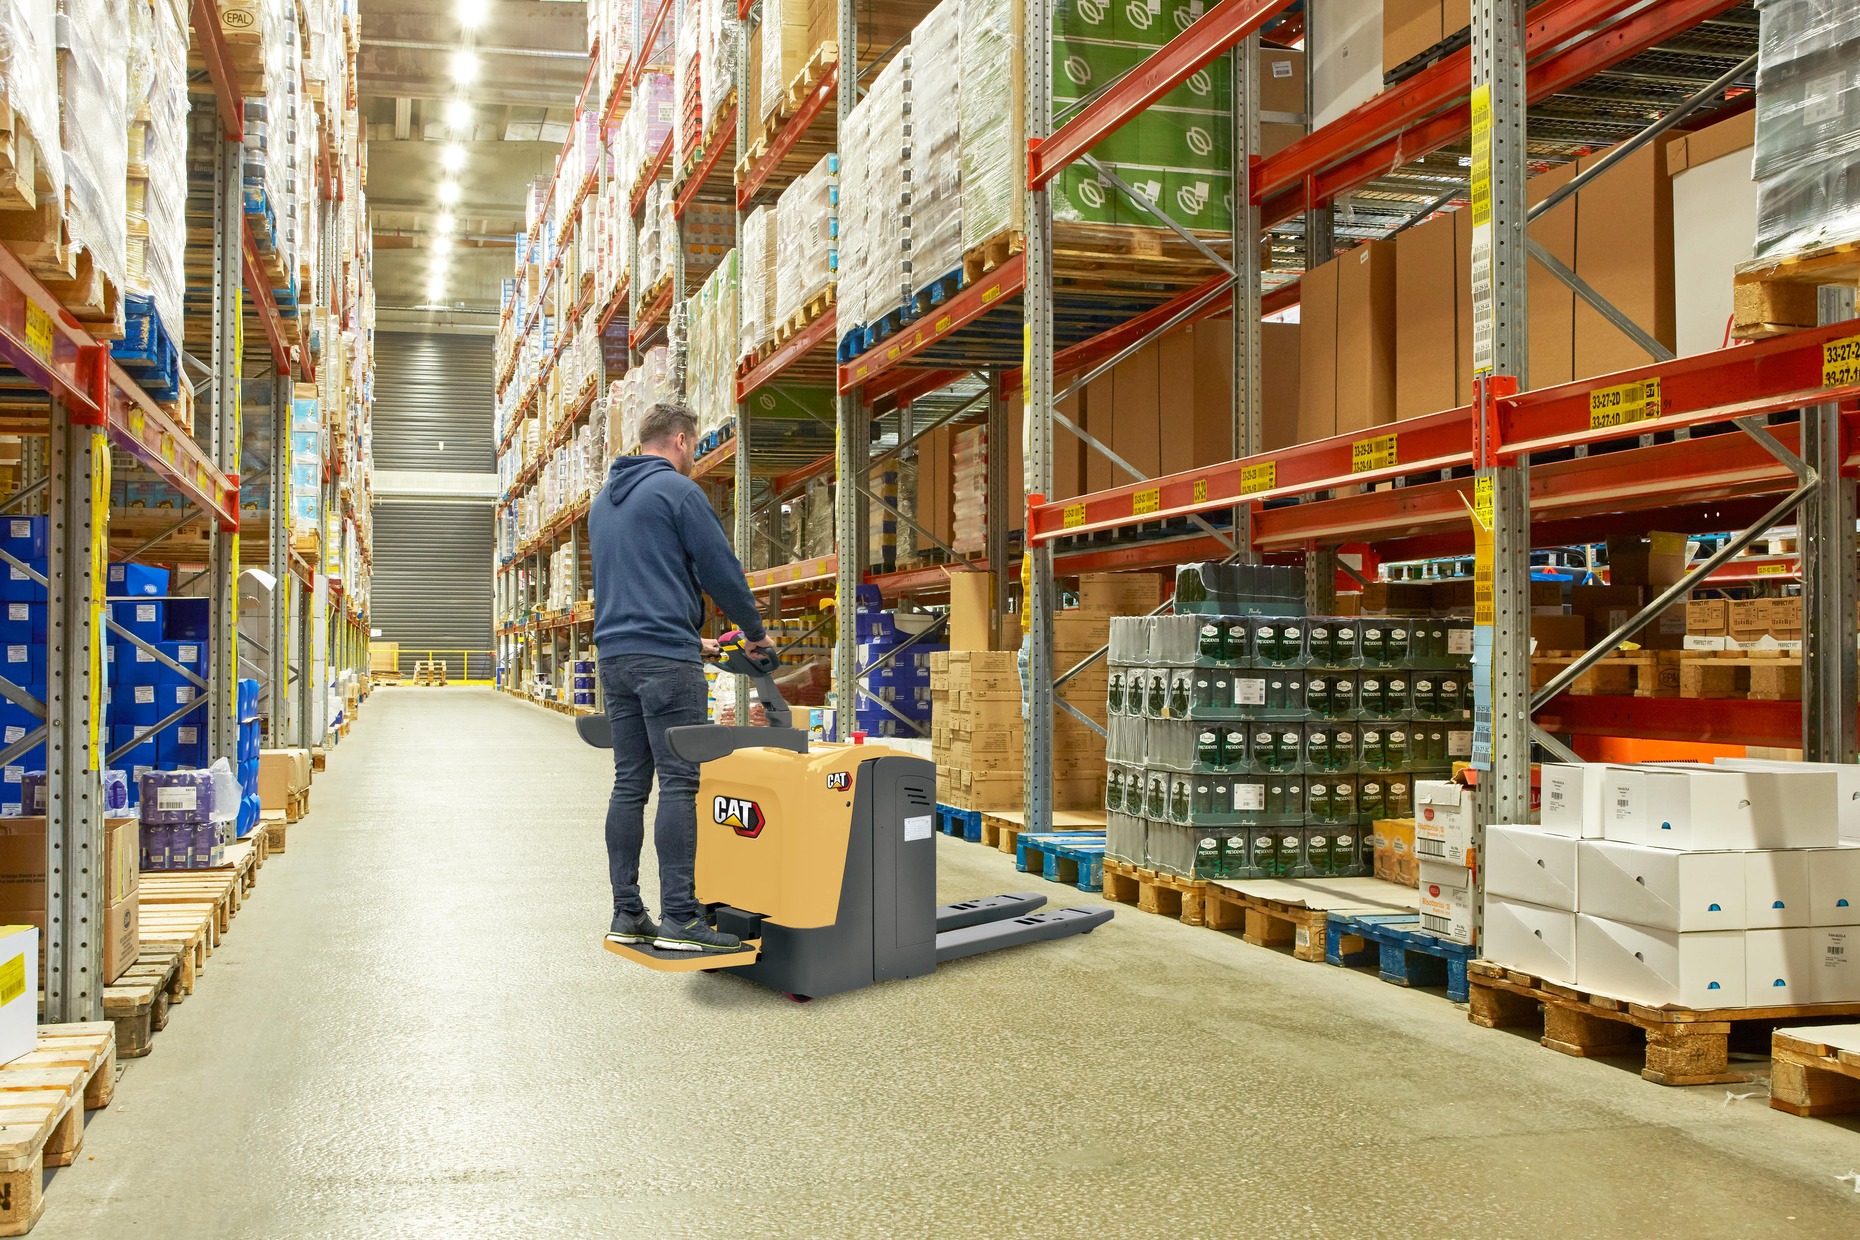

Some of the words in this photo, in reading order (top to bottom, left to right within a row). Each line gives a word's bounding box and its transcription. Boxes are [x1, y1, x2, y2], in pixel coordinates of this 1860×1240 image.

[227, 13, 249, 24] EPAL
[1592, 392, 1620, 409] 33-27-2D
[1355, 443, 1373, 457] 33-29-2A
[1195, 480, 1207, 502] 33-29
[828, 772, 846, 788] CAT
[714, 796, 752, 828] CAT
